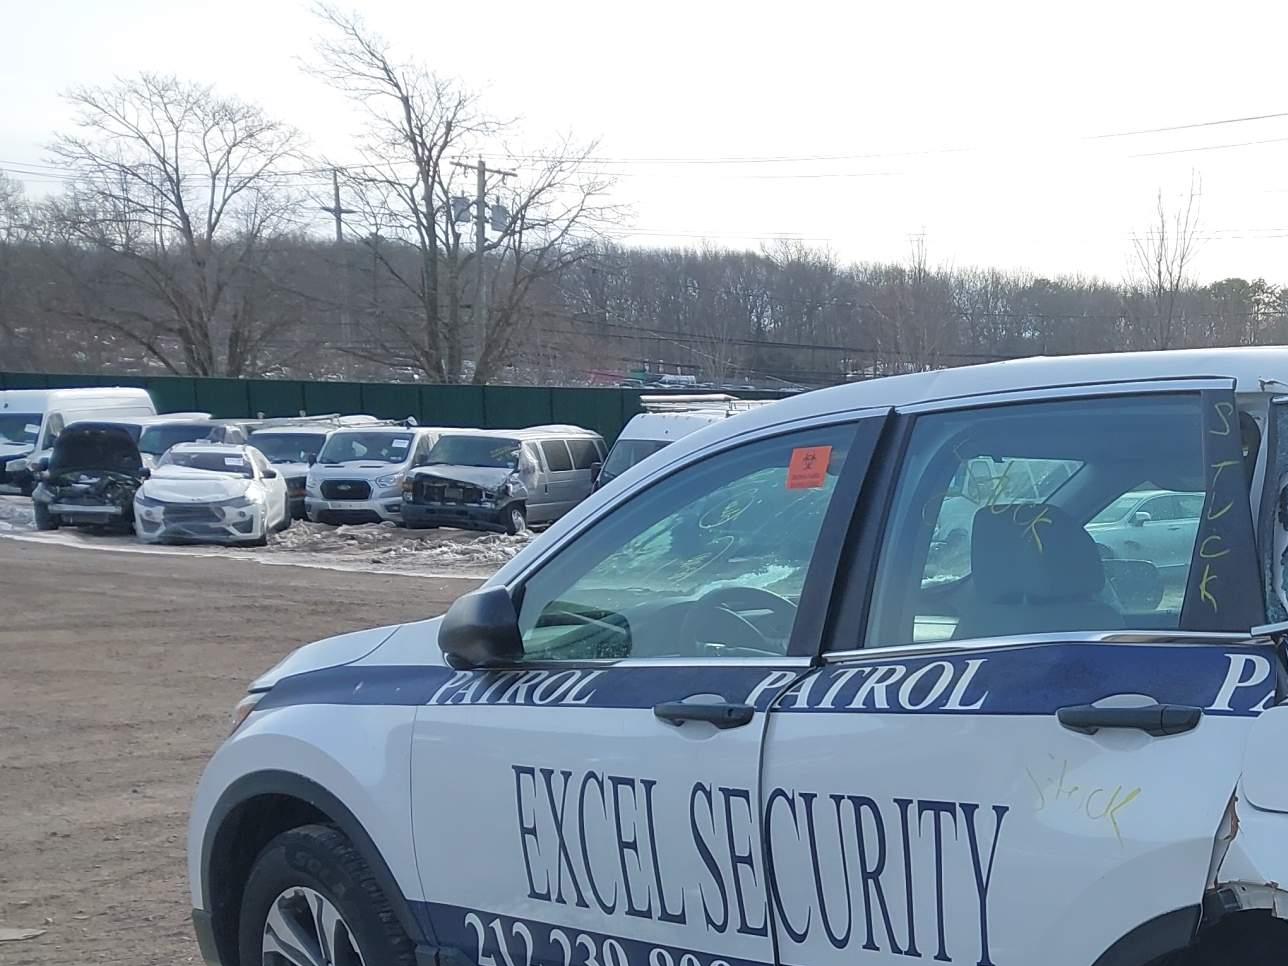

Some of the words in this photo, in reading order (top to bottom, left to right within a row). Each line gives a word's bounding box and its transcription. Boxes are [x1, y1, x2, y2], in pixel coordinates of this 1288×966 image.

[426, 669, 608, 705] PATROL
[743, 658, 990, 711] PATROL
[511, 764, 687, 925] EXCEL
